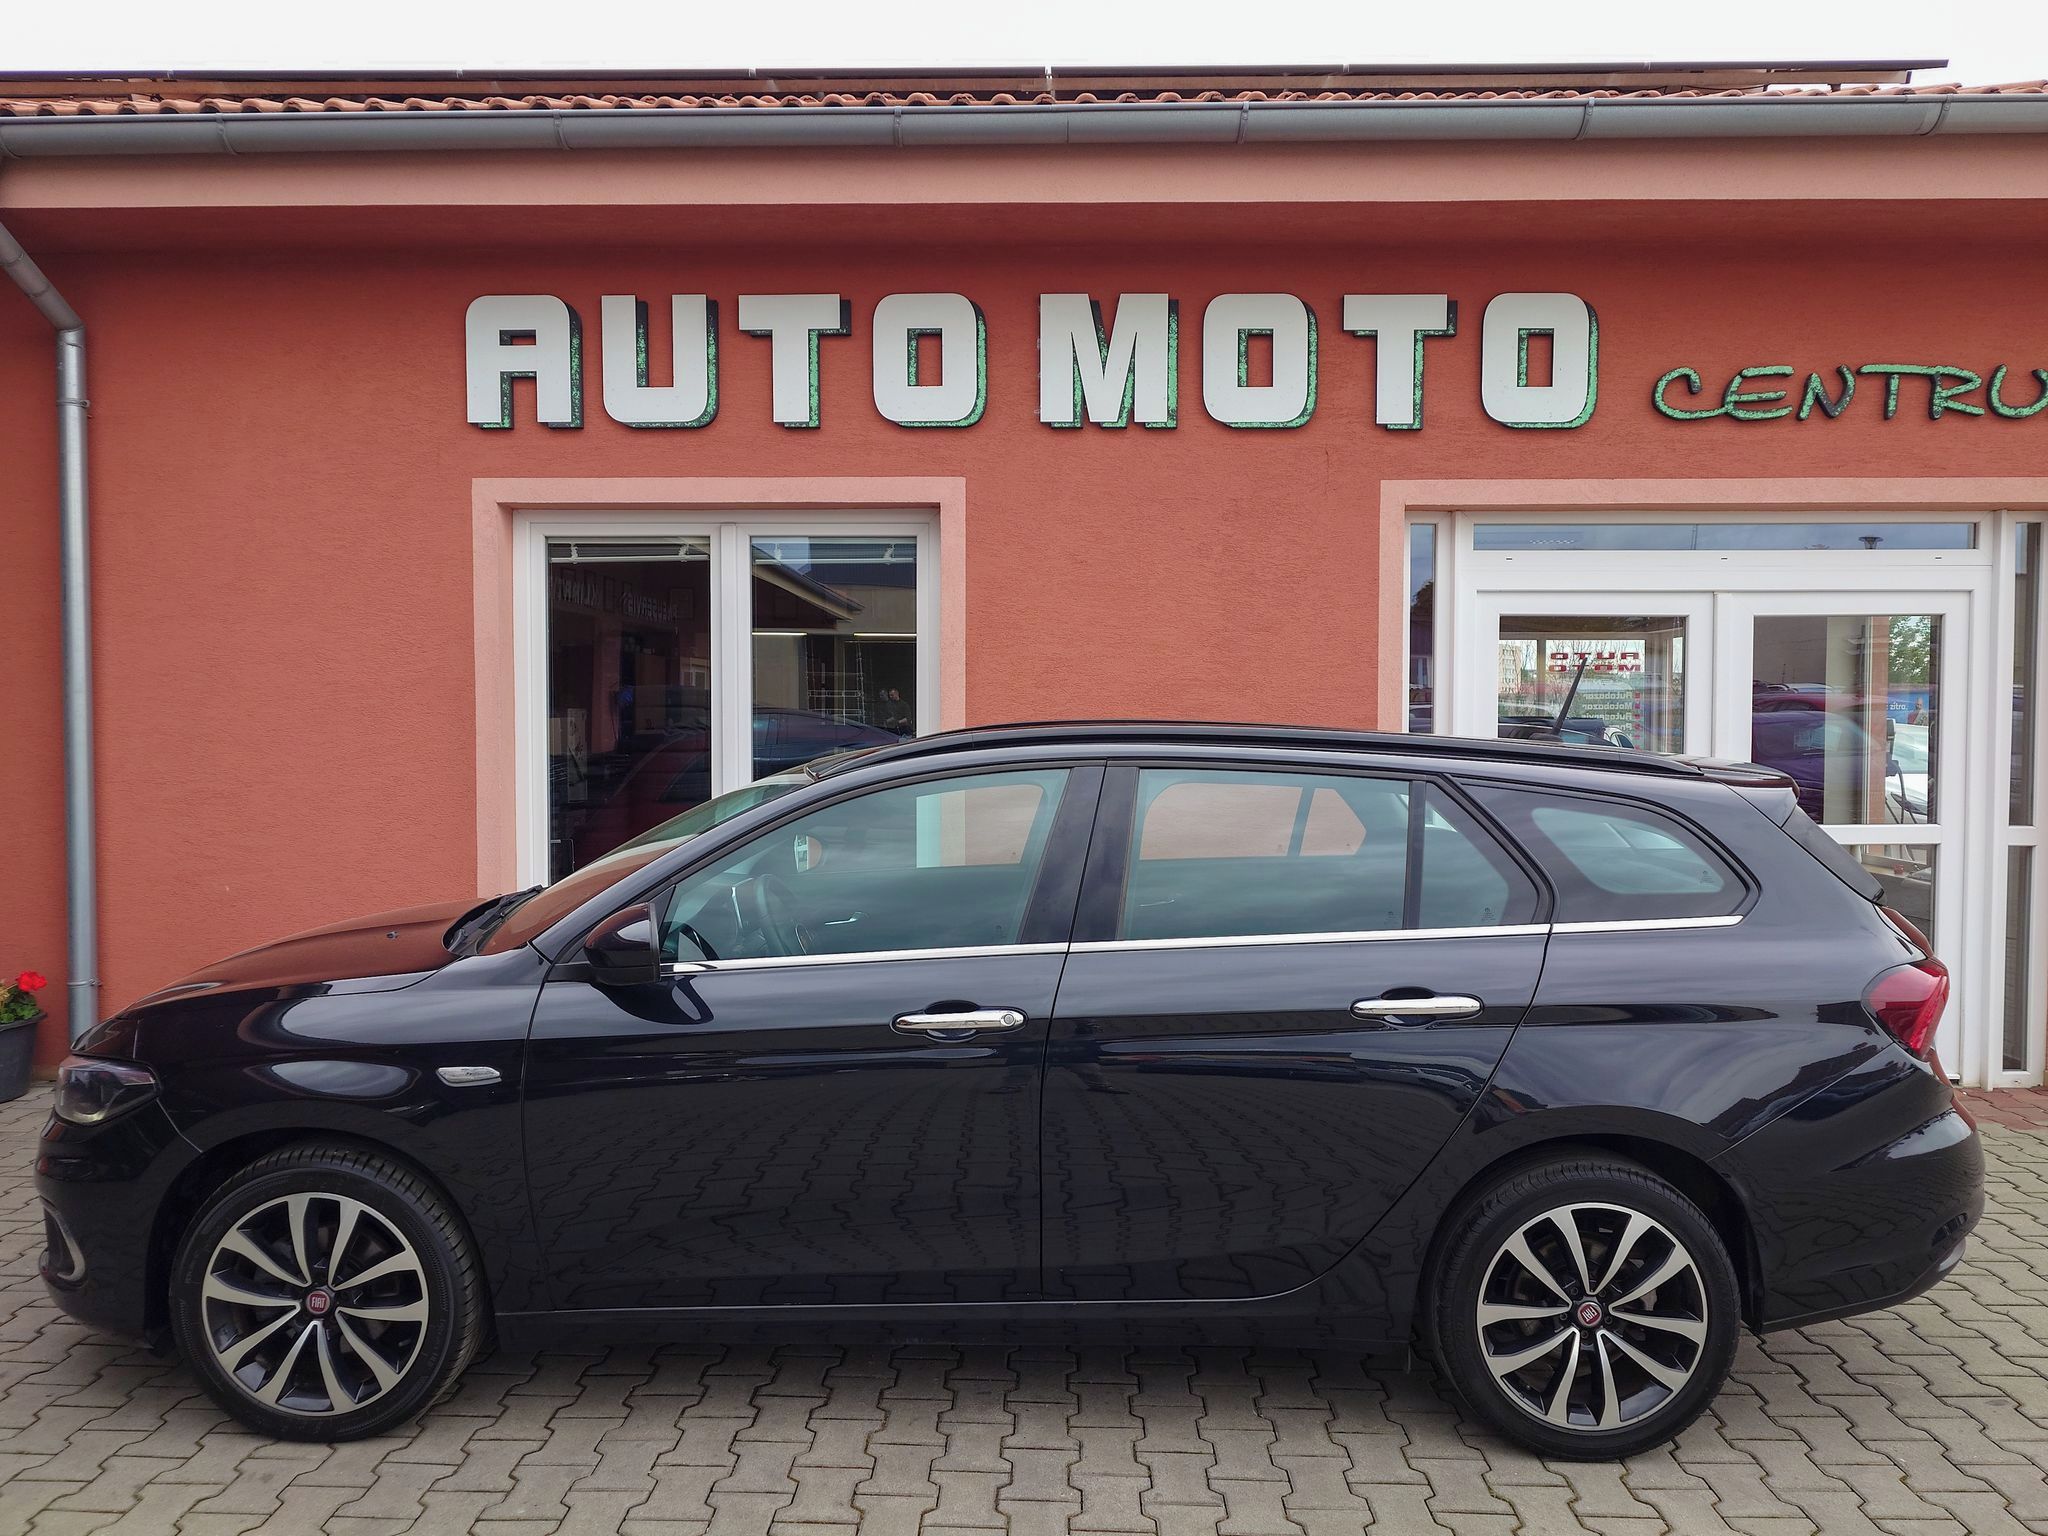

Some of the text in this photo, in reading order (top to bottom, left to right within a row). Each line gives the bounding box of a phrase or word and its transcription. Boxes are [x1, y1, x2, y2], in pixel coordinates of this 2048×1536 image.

[465, 292, 2048, 430] AUTO MOTO CENTRU
[311, 1296, 326, 1309] FIAT
[1581, 1306, 1598, 1322] FIAT
